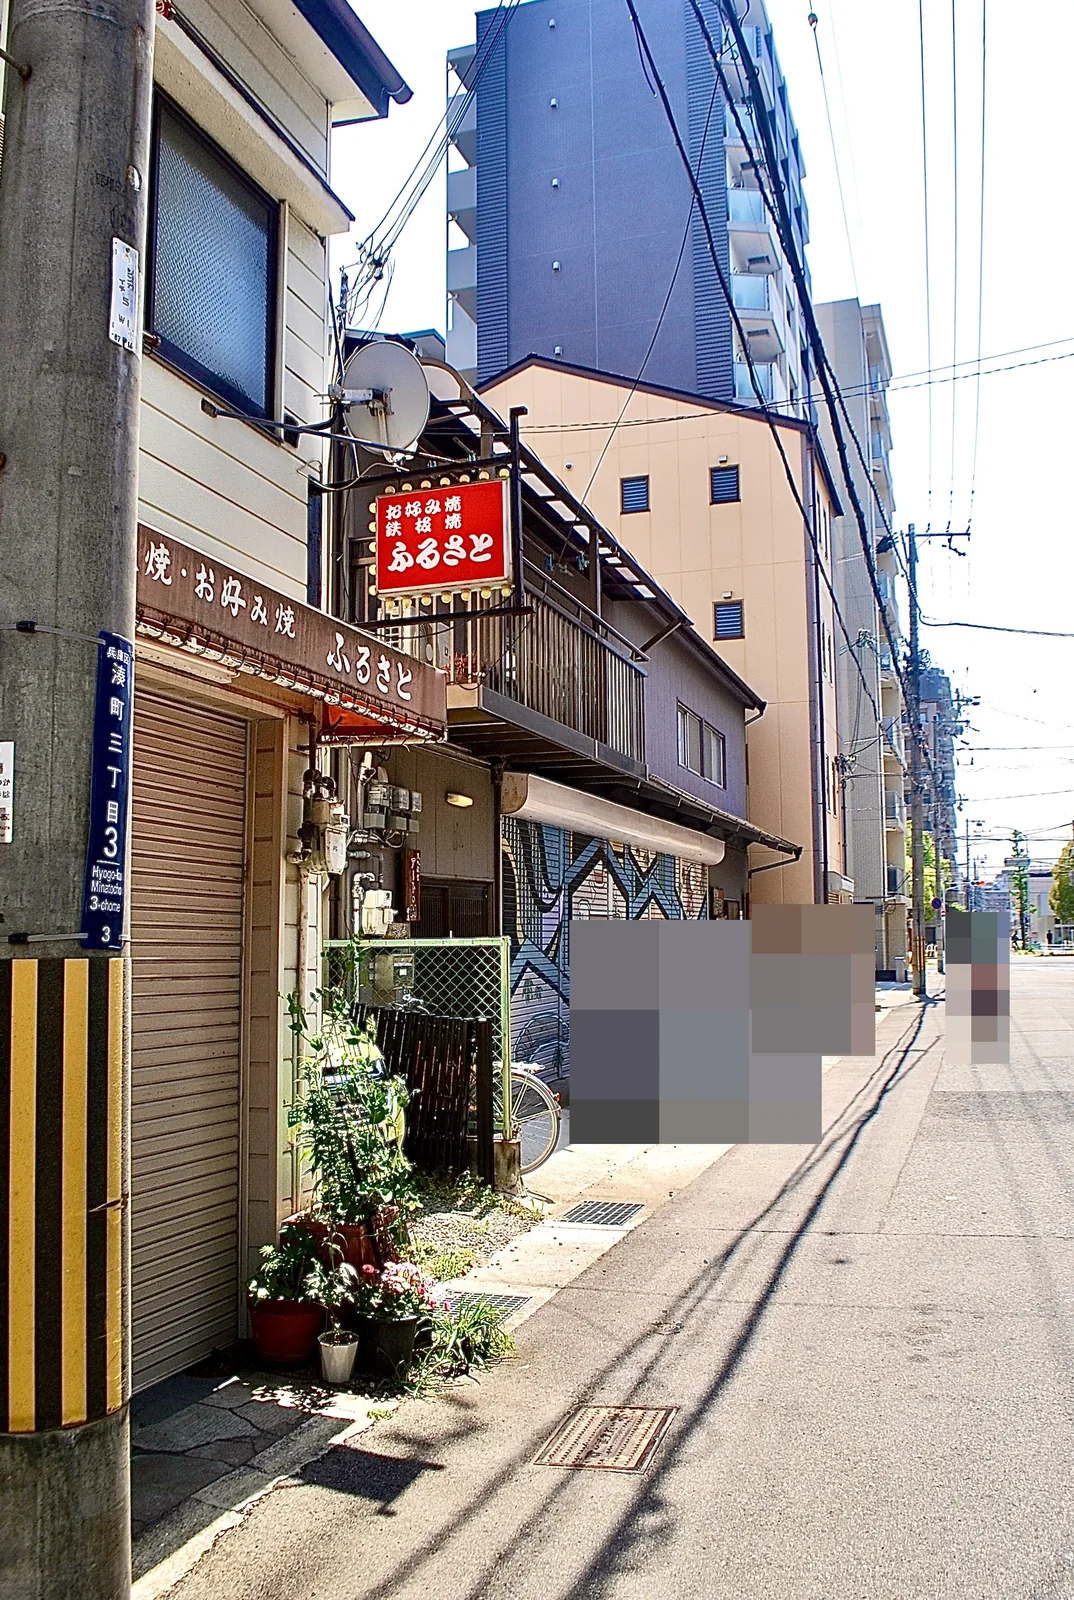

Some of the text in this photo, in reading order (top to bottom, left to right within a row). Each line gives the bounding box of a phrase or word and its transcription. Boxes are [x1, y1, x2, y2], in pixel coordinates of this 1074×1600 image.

[385, 495, 462, 520] お好み焼
[387, 533, 494, 573] ふるさと
[326, 631, 412, 701] ふるさと
[101, 926, 111, 943] 3
